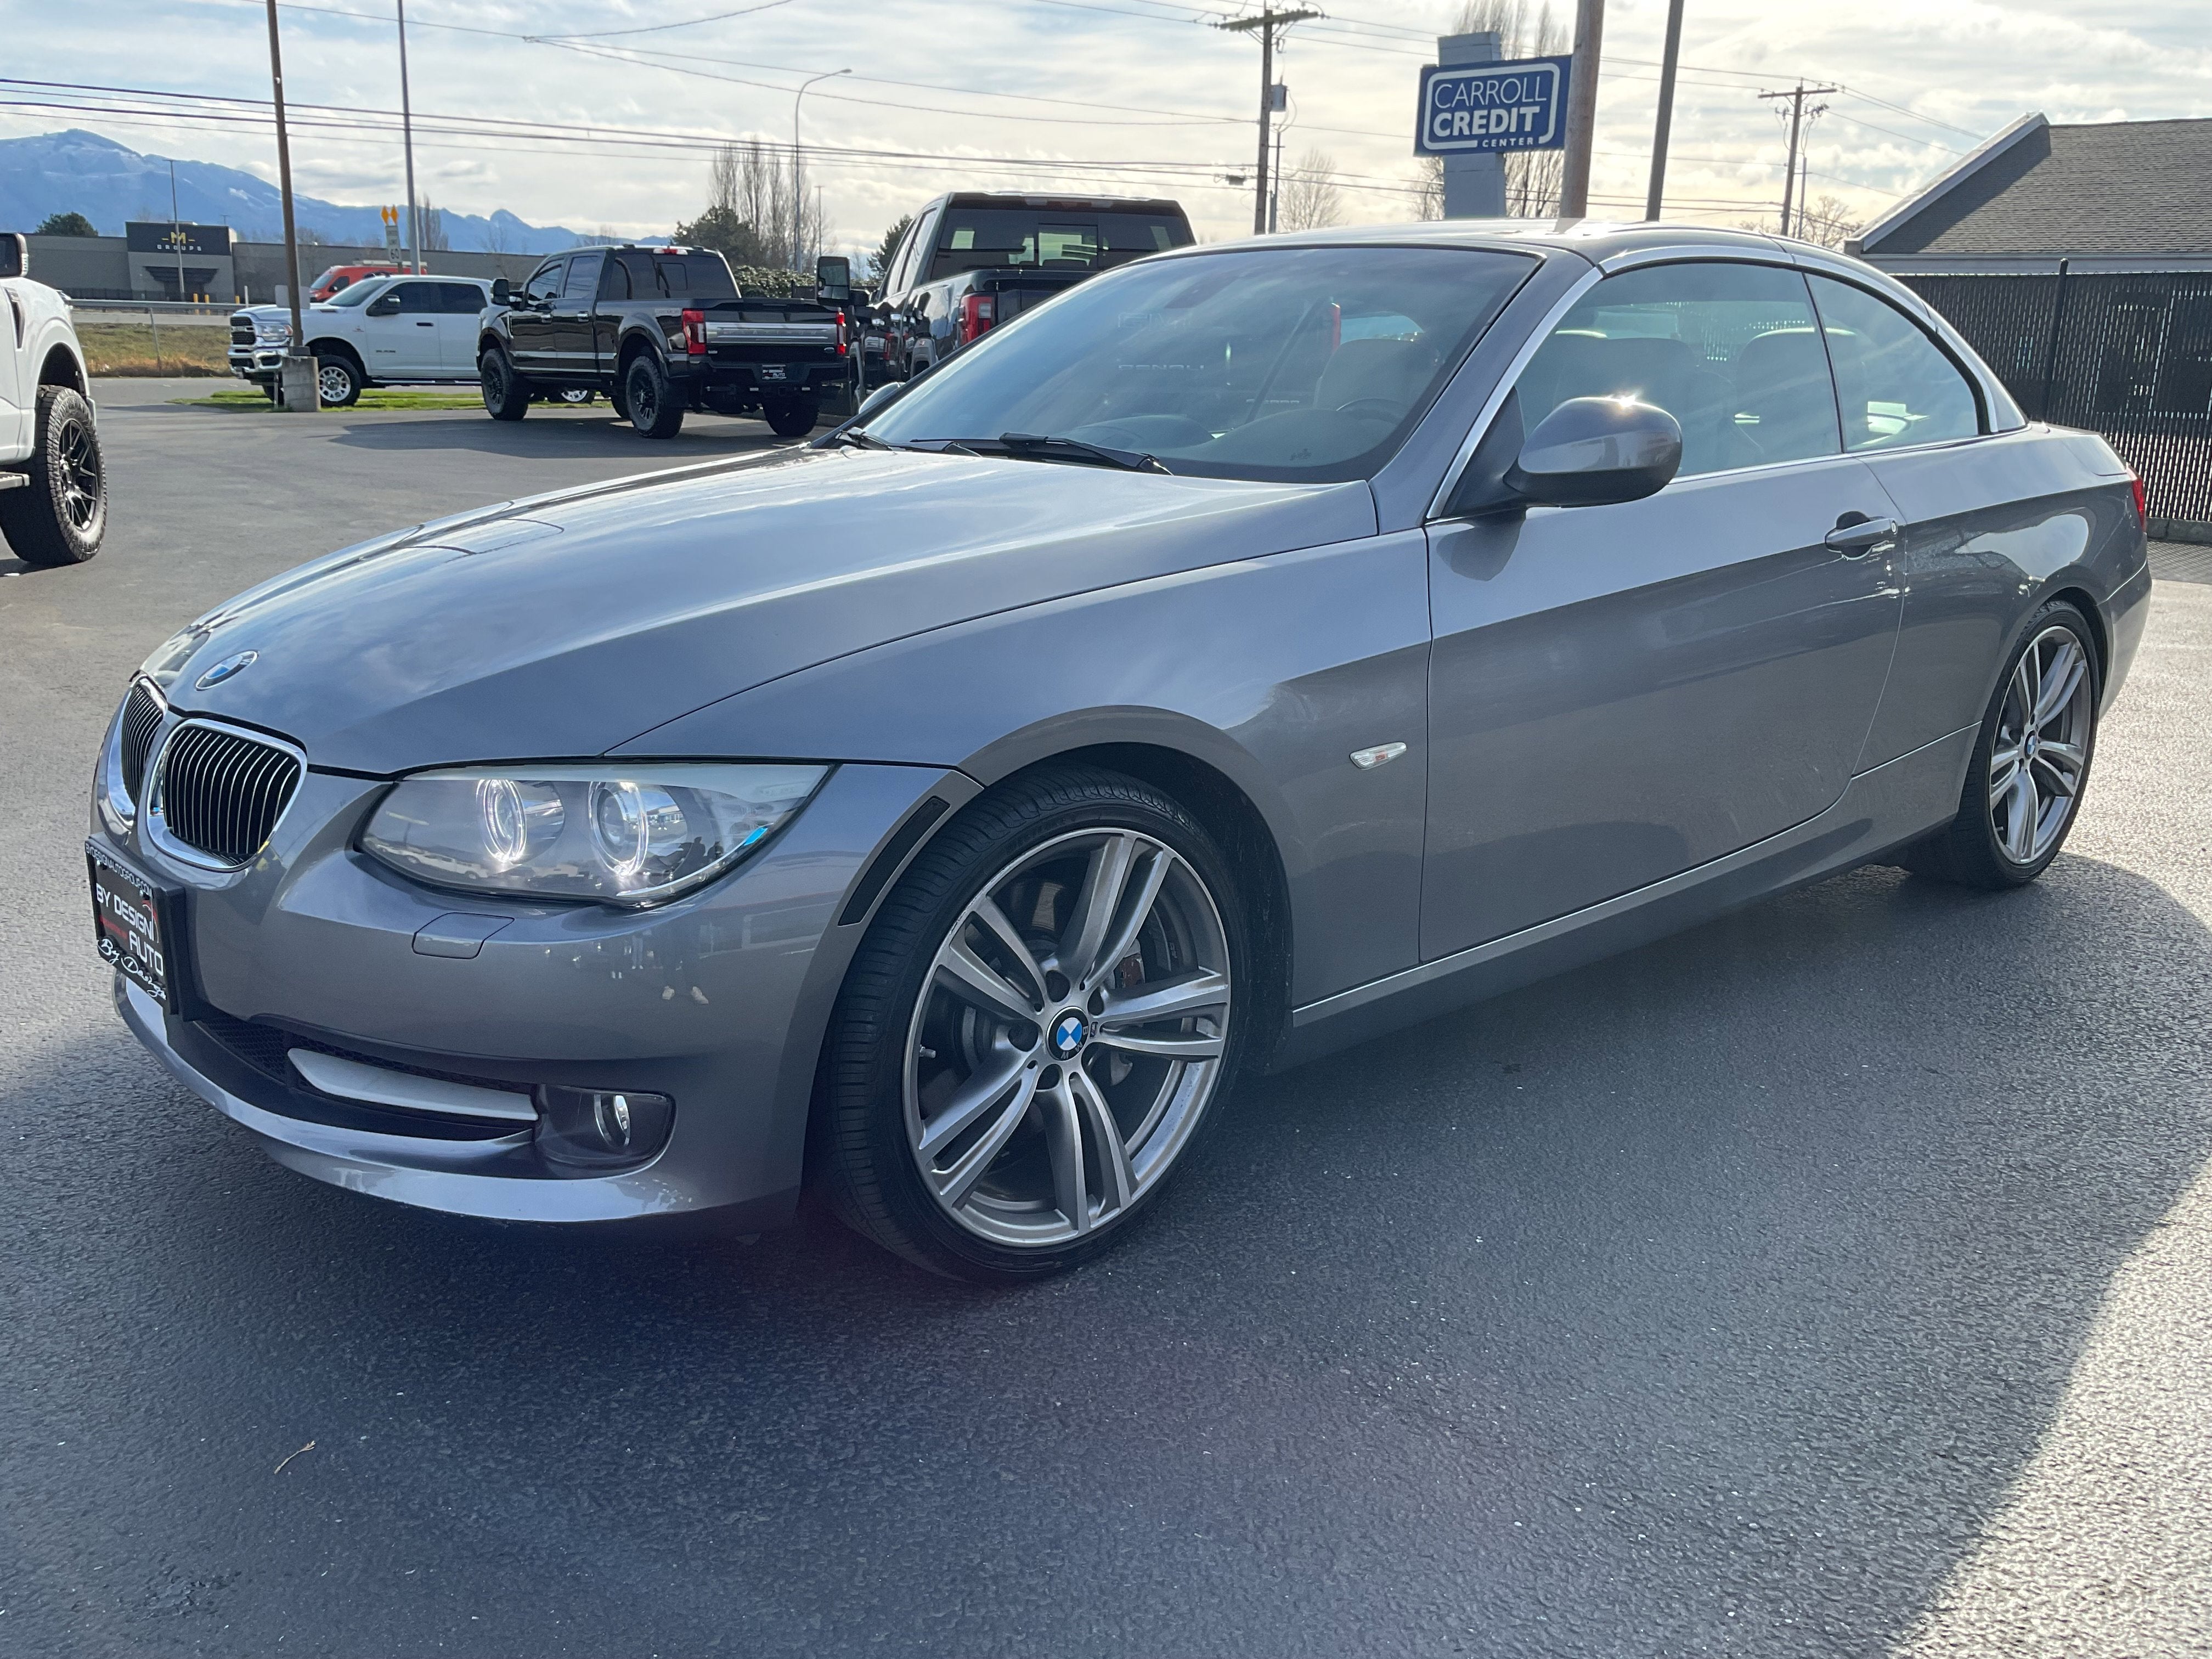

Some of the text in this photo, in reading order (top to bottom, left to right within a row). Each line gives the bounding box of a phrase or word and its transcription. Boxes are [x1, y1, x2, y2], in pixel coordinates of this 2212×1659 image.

[1435, 76, 1547, 109] CARROLL
[1433, 106, 1540, 137] CREDIT
[1482, 137, 1533, 148] CENTER
[390, 248, 399, 259] 60
[96, 883, 154, 941] BY DESIGN
[129, 930, 163, 977] AUTO
